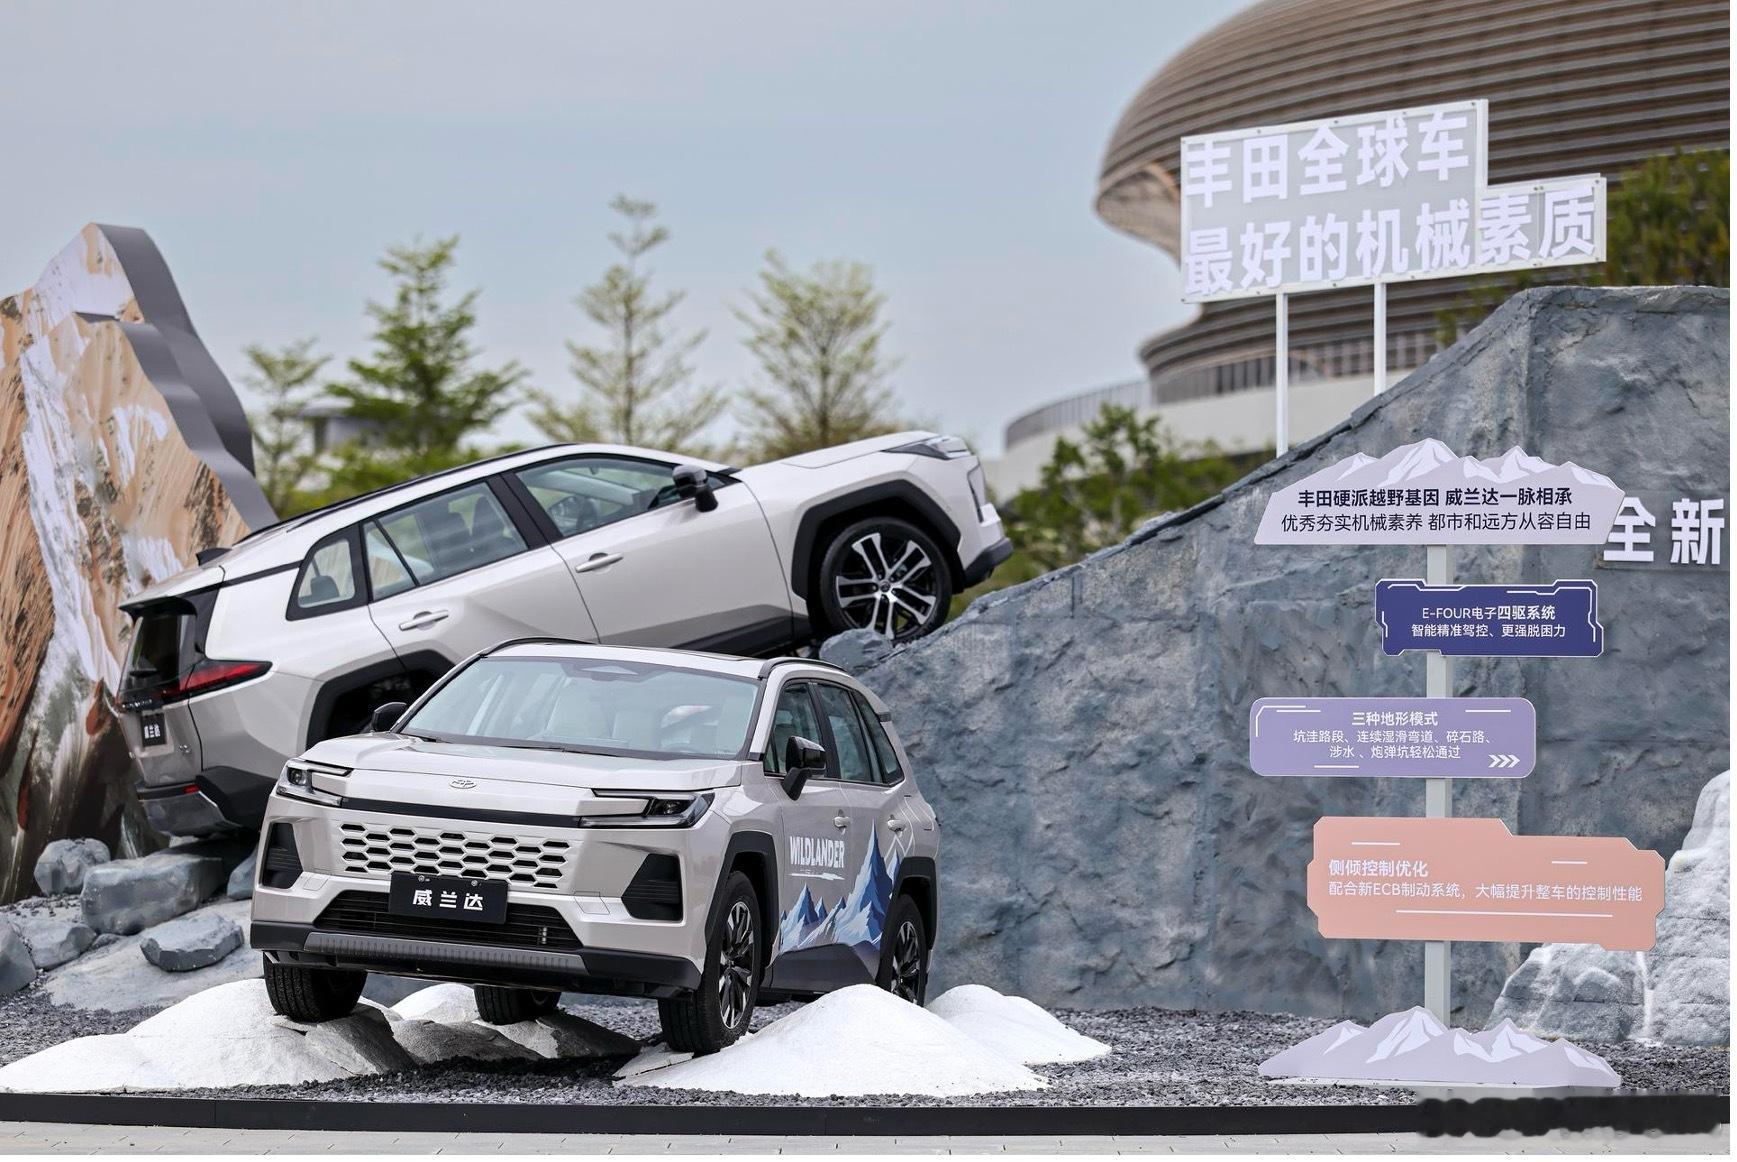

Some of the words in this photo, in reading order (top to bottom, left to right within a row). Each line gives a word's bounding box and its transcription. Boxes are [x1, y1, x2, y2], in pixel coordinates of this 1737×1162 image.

[1185, 111, 1470, 208] 丰田全球车
[1185, 186, 1596, 296] 最好的机械素质
[1298, 489, 1440, 507] 丰田硬派越野基因
[1445, 487, 1573, 506] 威兰达一脉相承
[1281, 514, 1424, 532] 优秀夯实机械素养
[1428, 512, 1591, 531] 都市和远方从容自由
[1603, 497, 1725, 565] 全新
[1422, 605, 1556, 620] E-FOUR电子四驱系统
[1411, 624, 1566, 638] 智能精准驾控、更强脱困力
[1351, 711, 1439, 726] 三种地形模式
[789, 835, 845, 869] WILDLANDER
[1328, 859, 1429, 877] 侧倾控制优化
[412, 889, 484, 911] 威兰达
